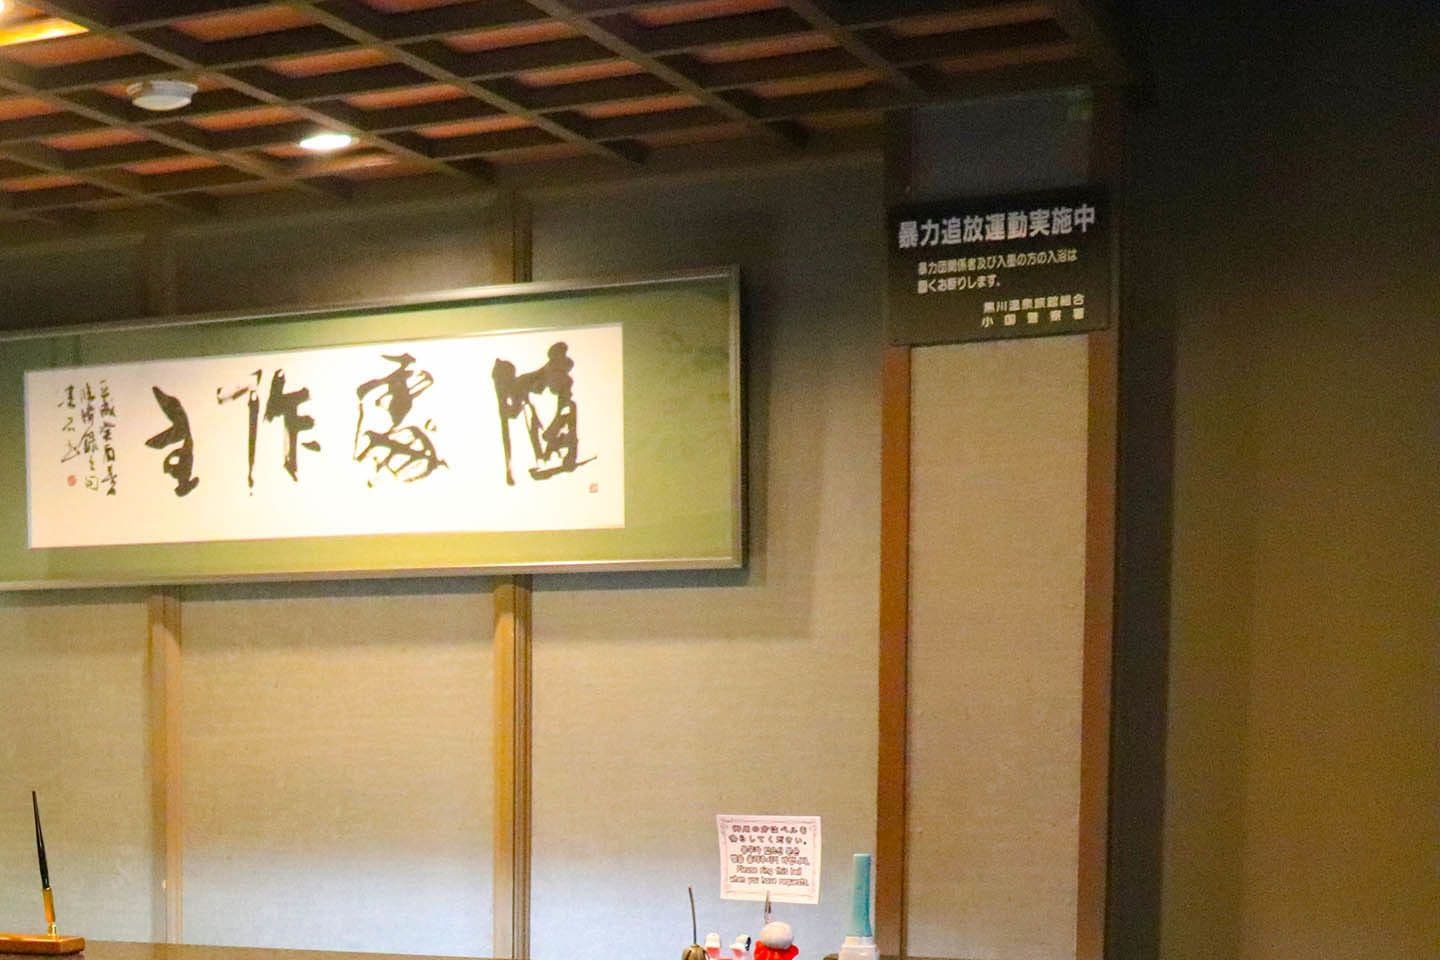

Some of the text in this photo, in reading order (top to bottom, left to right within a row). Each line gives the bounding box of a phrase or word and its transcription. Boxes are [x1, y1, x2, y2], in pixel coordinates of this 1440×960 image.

[898, 204, 1096, 249] 暴力追放運動実施中
[983, 294, 1085, 314] 黒川温泉旅館組合
[981, 307, 1085, 328] 小国警察署
